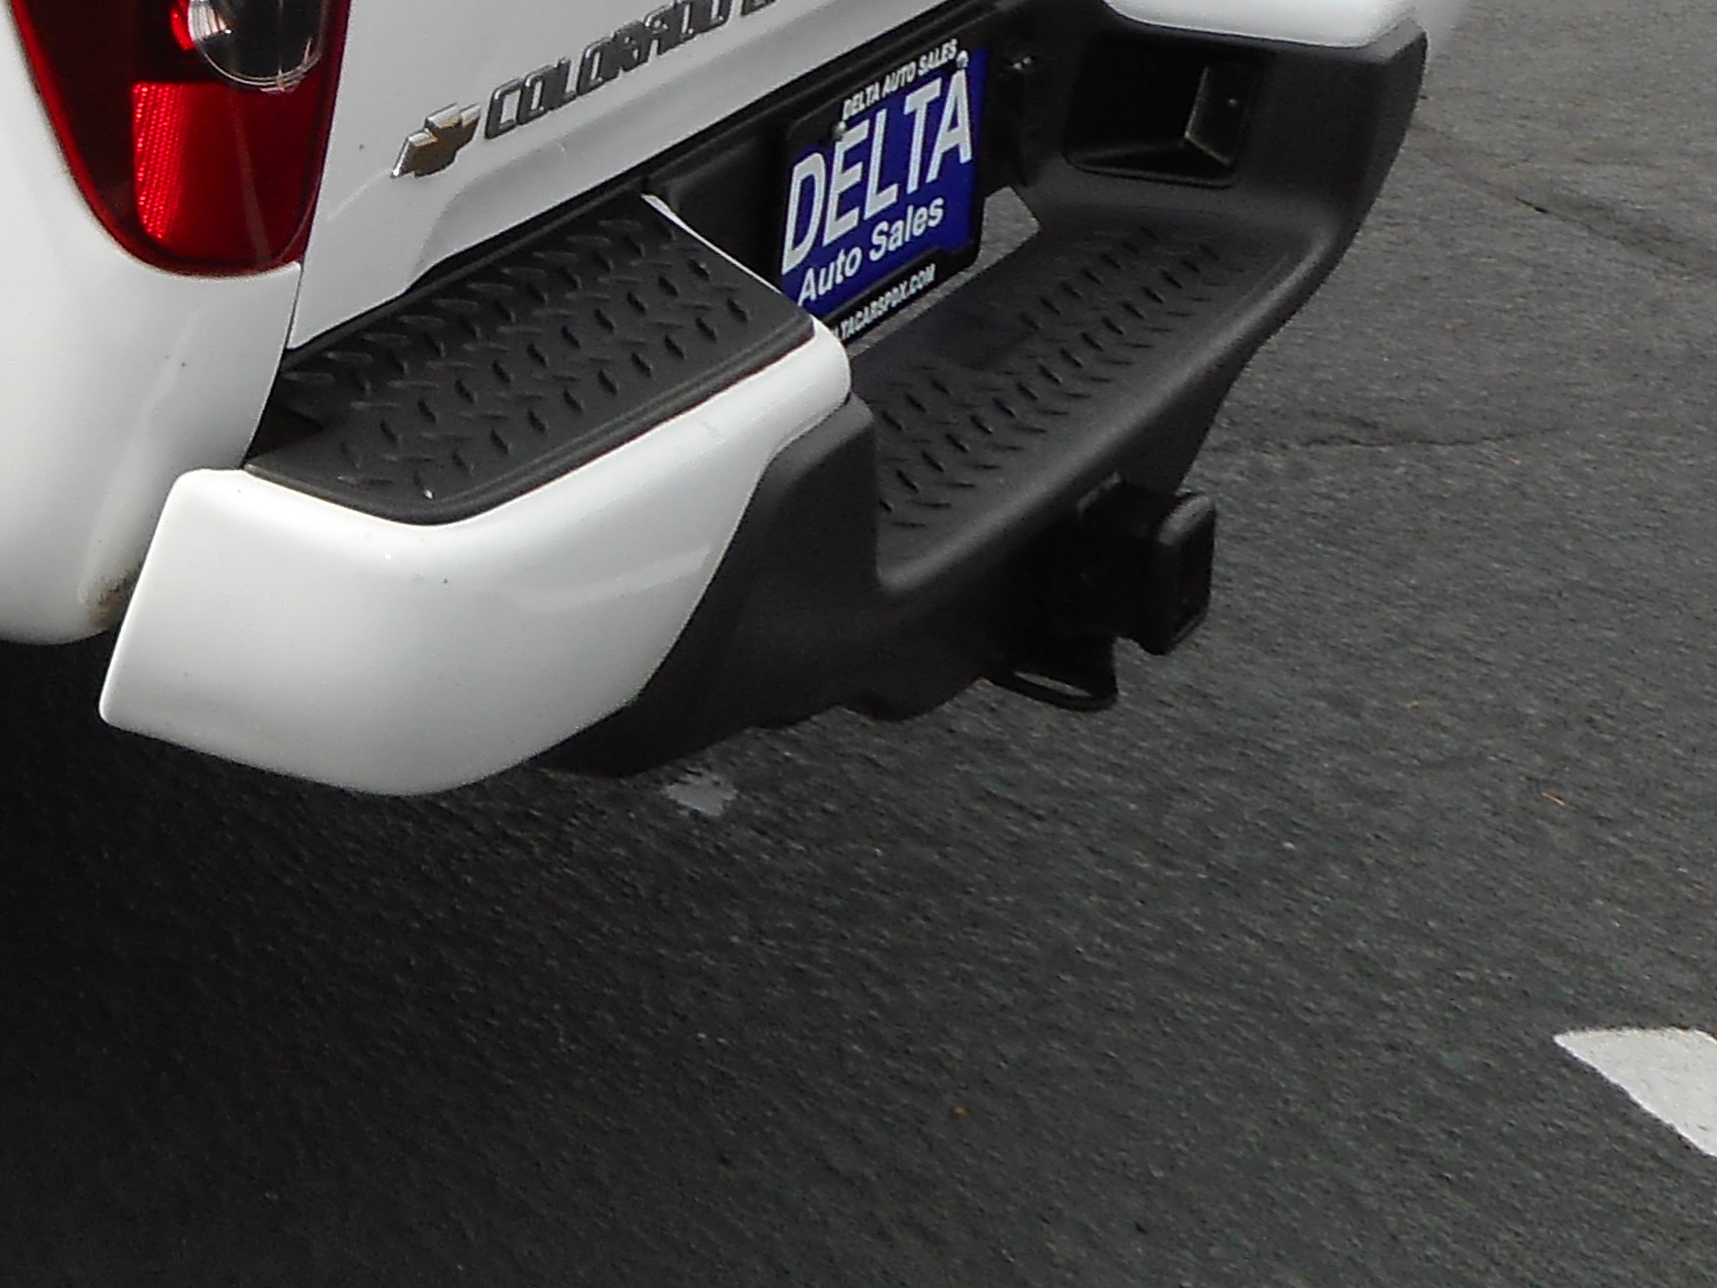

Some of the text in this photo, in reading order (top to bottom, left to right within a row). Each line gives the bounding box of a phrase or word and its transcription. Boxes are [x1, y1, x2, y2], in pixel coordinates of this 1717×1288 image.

[842, 39, 958, 121] DELTA AUTO SALES
[782, 69, 972, 275] DELTA
[797, 197, 944, 307] Auto Sales
